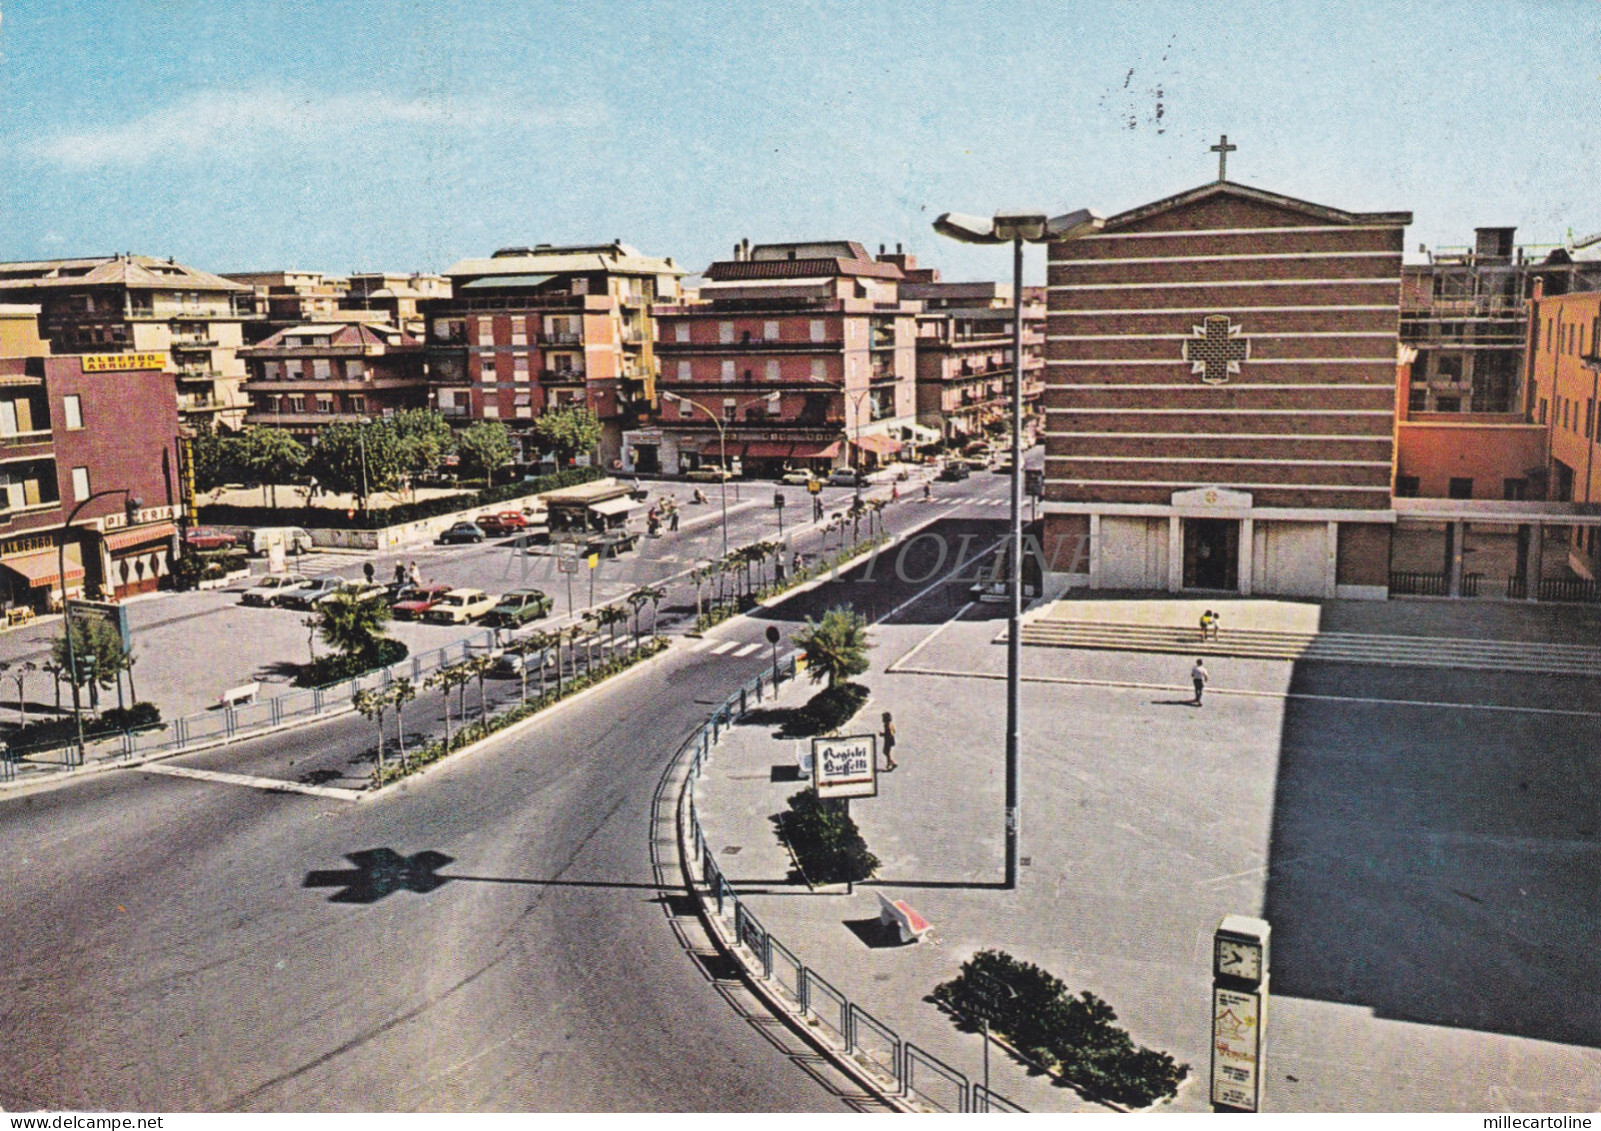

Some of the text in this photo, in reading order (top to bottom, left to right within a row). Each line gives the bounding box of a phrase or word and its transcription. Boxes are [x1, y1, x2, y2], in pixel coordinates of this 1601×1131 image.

[87, 354, 155, 363] ALBERGO
[108, 507, 174, 526] PIERIA
[823, 747, 867, 762] Registri
[824, 759, 867, 776] Buffetti
